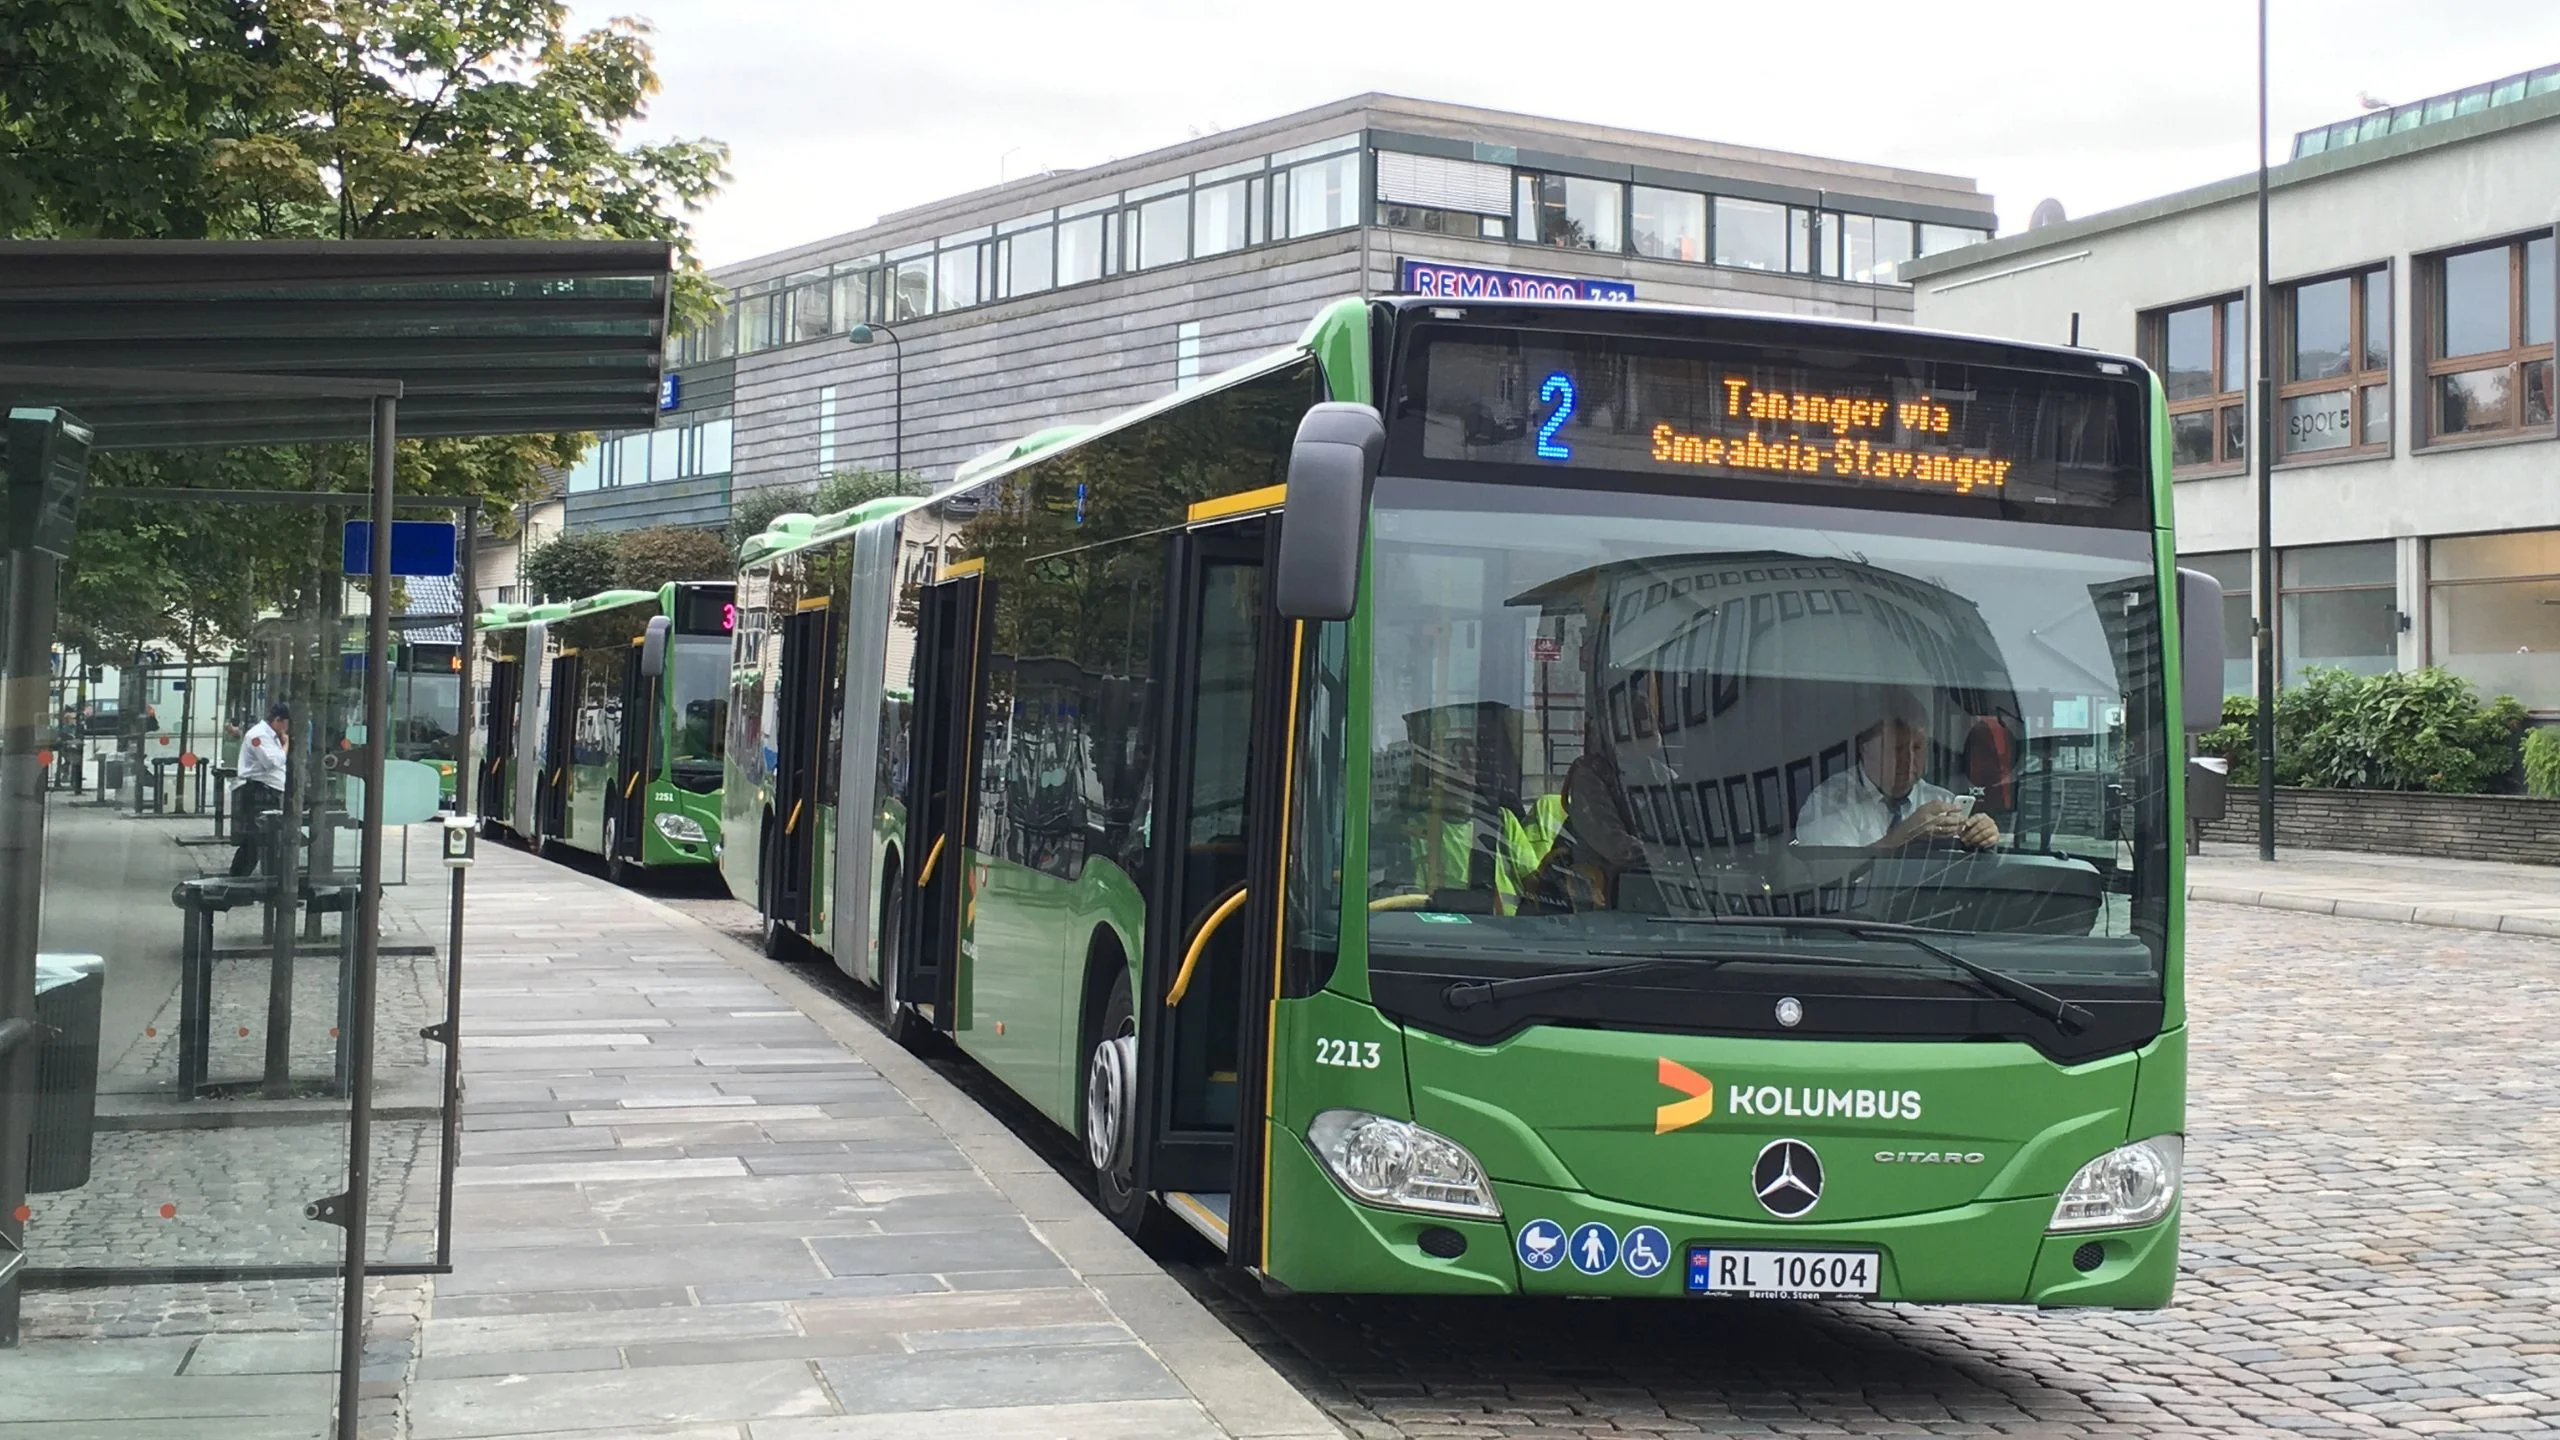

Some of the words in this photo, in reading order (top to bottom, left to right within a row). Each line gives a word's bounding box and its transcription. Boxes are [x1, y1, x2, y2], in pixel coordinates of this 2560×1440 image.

[1413, 268, 1503, 299] REMA
[1509, 280, 1576, 300] 1000
[1538, 376, 1573, 459] 2
[1723, 379, 1889, 435] Tananger
[1899, 396, 1951, 432] via
[2290, 411, 2337, 442] spor
[2340, 408, 2350, 429] 5
[1652, 423, 2011, 493] Smeaheia-Stavanger
[723, 603, 735, 629] 3
[1315, 1037, 1381, 1069] 2213
[1729, 1085, 1922, 1120] KOLUMBUS
[1874, 1151, 1985, 1164] CITARO
[1694, 1274, 1704, 1284] N
[1719, 1256, 1757, 1286] RL
[1773, 1257, 1868, 1288] 10604
[1749, 1290, 1778, 1300] Bertel
[1780, 1290, 1791, 1300] O.
[1793, 1291, 1820, 1300] Steen
